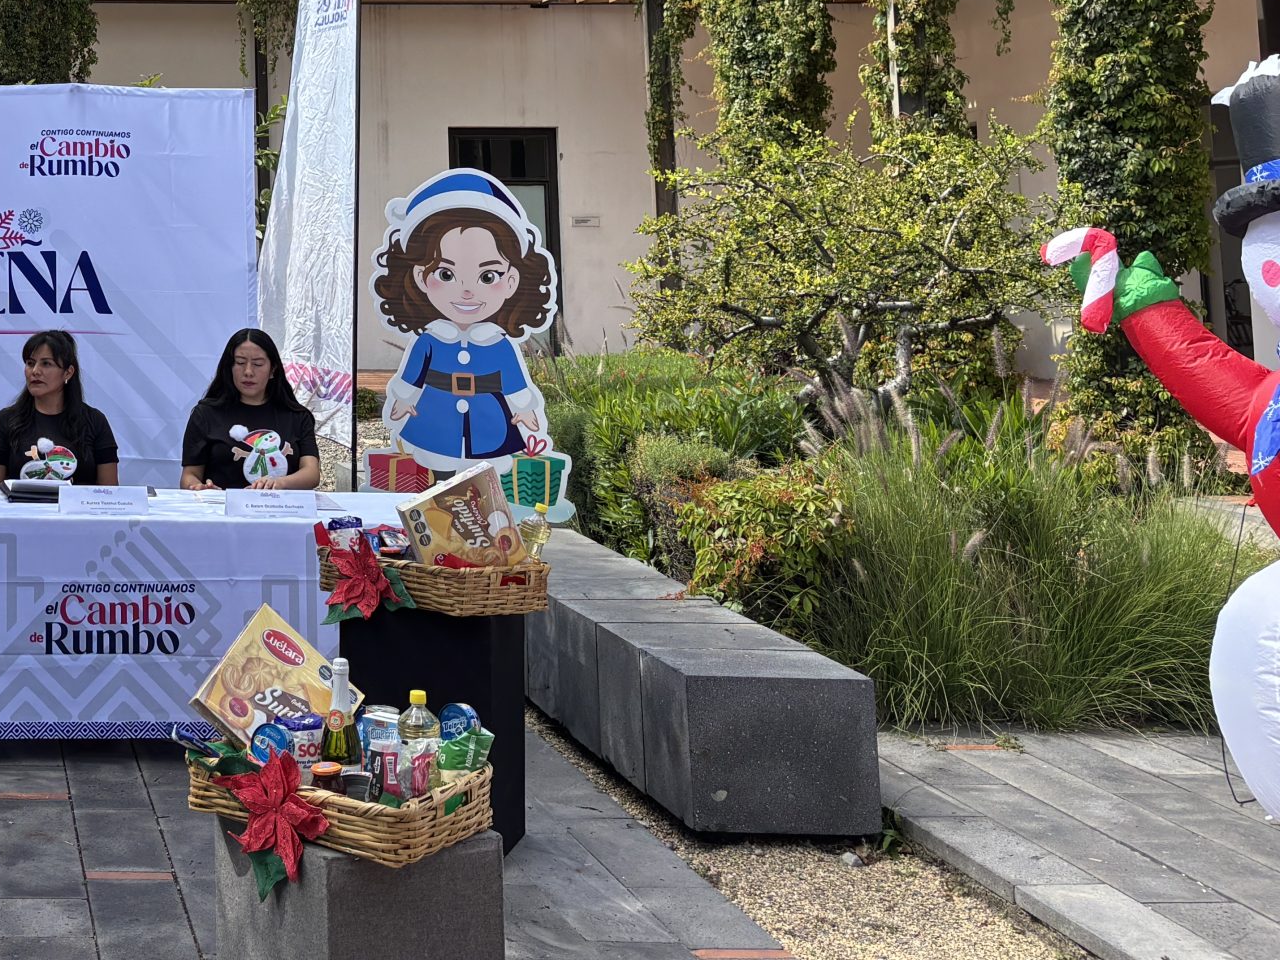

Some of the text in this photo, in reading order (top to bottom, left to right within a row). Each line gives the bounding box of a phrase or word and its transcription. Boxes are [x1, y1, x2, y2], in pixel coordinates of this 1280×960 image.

[40, 128, 131, 139] CONTIGO CONTINUAMOS
[29, 136, 131, 159] el Cambio
[19, 154, 120, 178] de Rumbo
[452, 499, 491, 548] Surtido
[470, 500, 488, 526] Casero
[61, 583, 196, 594] CONTIGO CONTINUAMOS
[45, 594, 196, 626] el Cambio
[29, 620, 180, 656] de Rumbo
[263, 630, 304, 665] Cuétara
